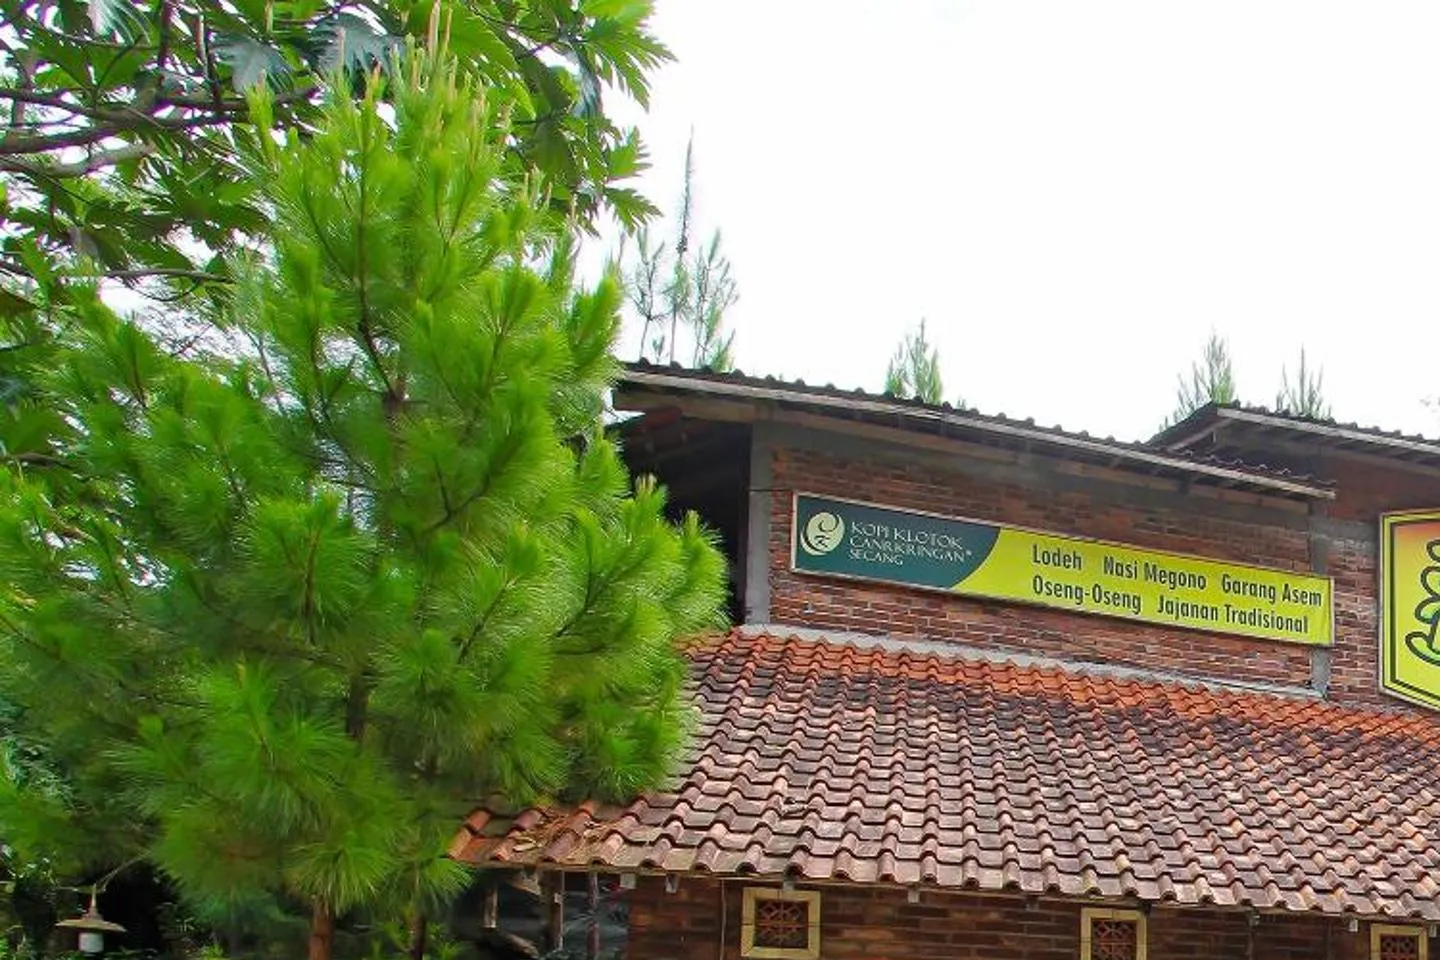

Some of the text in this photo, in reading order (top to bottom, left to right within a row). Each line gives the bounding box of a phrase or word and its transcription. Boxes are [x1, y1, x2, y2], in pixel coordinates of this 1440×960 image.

[851, 521, 963, 550] KOPI KLOTOK
[1032, 543, 1322, 607] Lodeh Nasi Megono Garang Asem
[1032, 575, 1309, 634] Oseng-Oseng Jajanan Tradisional
